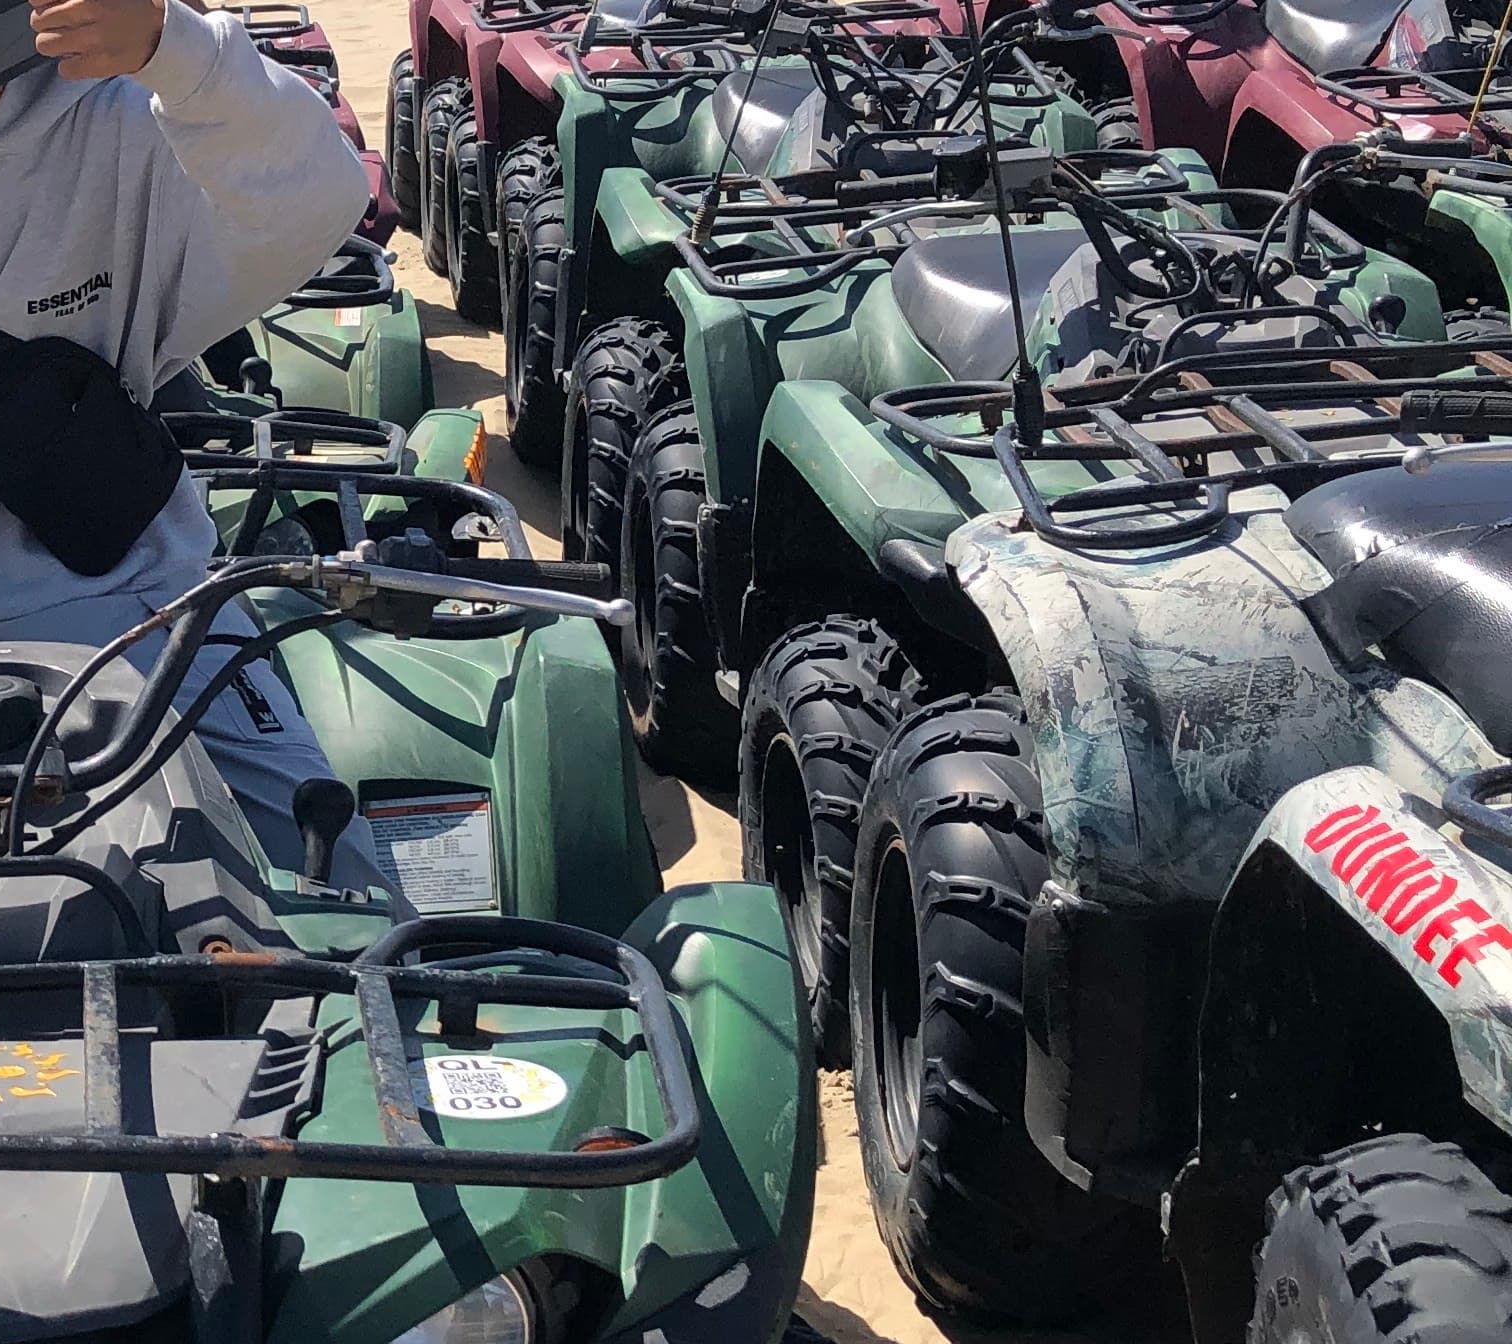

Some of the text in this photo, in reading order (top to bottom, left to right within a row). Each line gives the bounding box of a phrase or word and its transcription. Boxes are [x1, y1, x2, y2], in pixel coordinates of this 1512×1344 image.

[27, 271, 112, 315] ESSENTIAL
[1304, 805, 1512, 989] DUNDEE
[449, 1095, 523, 1111] 030
